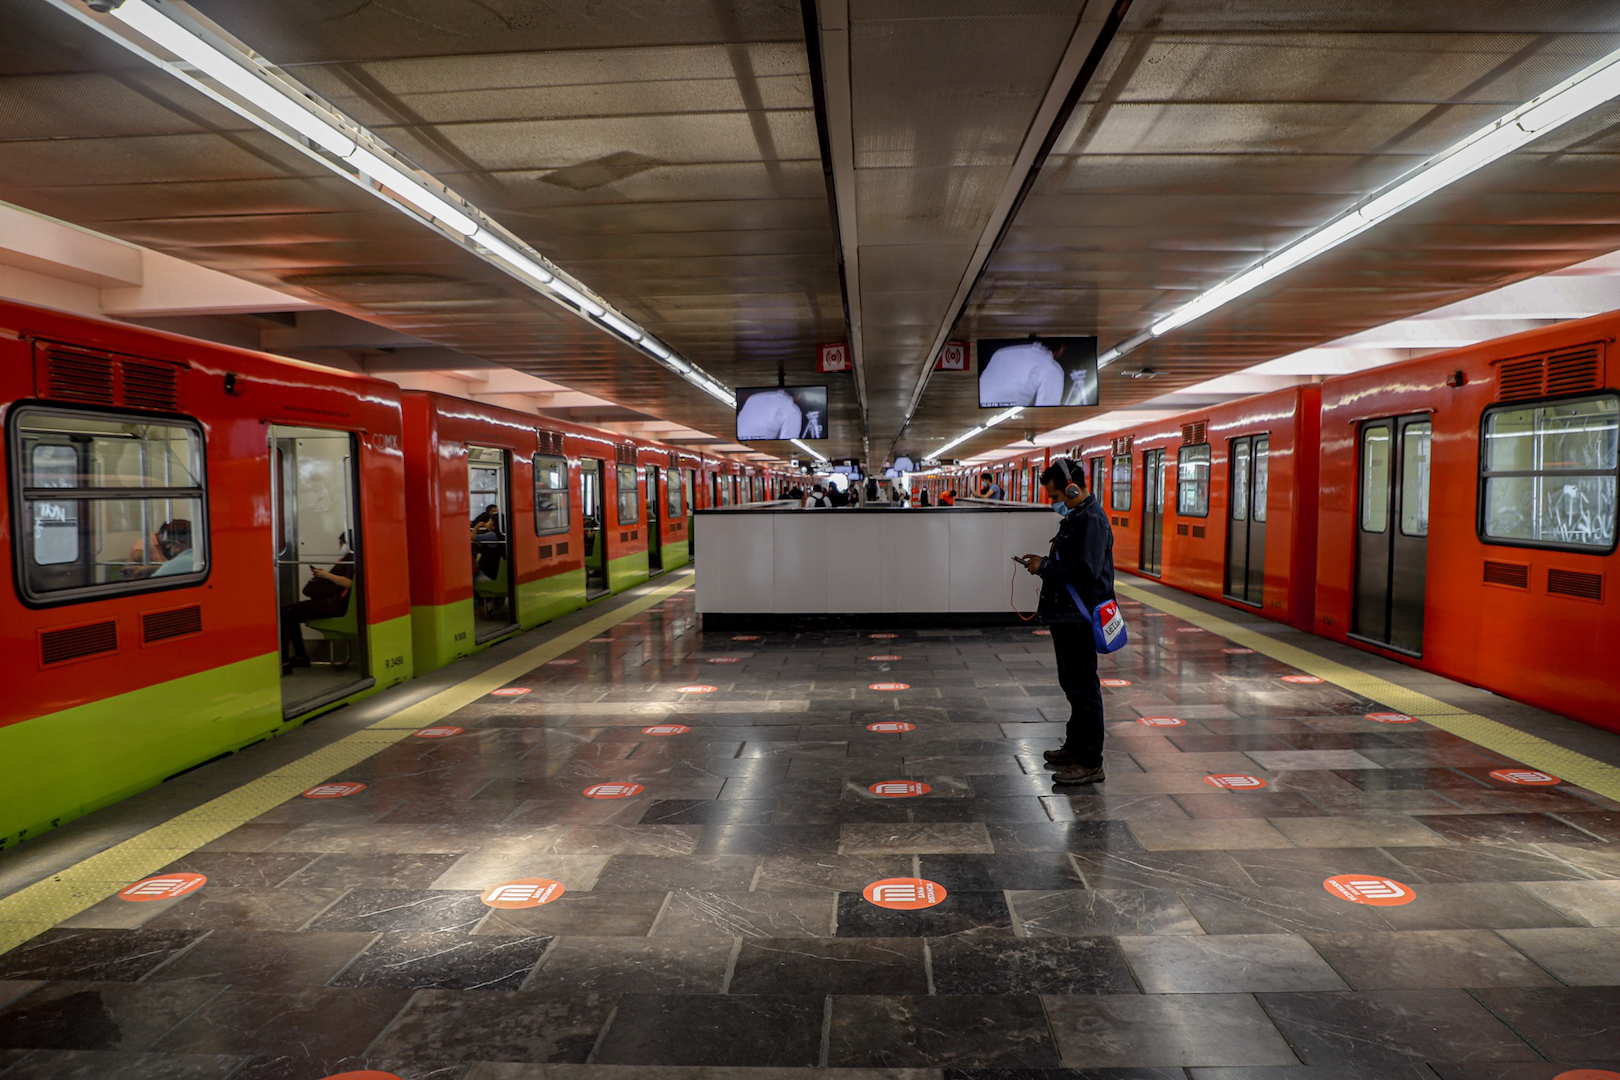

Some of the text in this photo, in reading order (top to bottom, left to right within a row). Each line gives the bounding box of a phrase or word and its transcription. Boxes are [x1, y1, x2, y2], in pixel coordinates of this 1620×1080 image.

[373, 433, 398, 449] CDMX
[385, 656, 404, 669] R.3456
[532, 887, 545, 898] SANA
[537, 883, 557, 903] DISTANCIA
[917, 887, 925, 898] SANA
[926, 883, 935, 903] DISTANCIA
[1328, 880, 1357, 900] DISTANCIA
[1343, 884, 1360, 895] SANA
